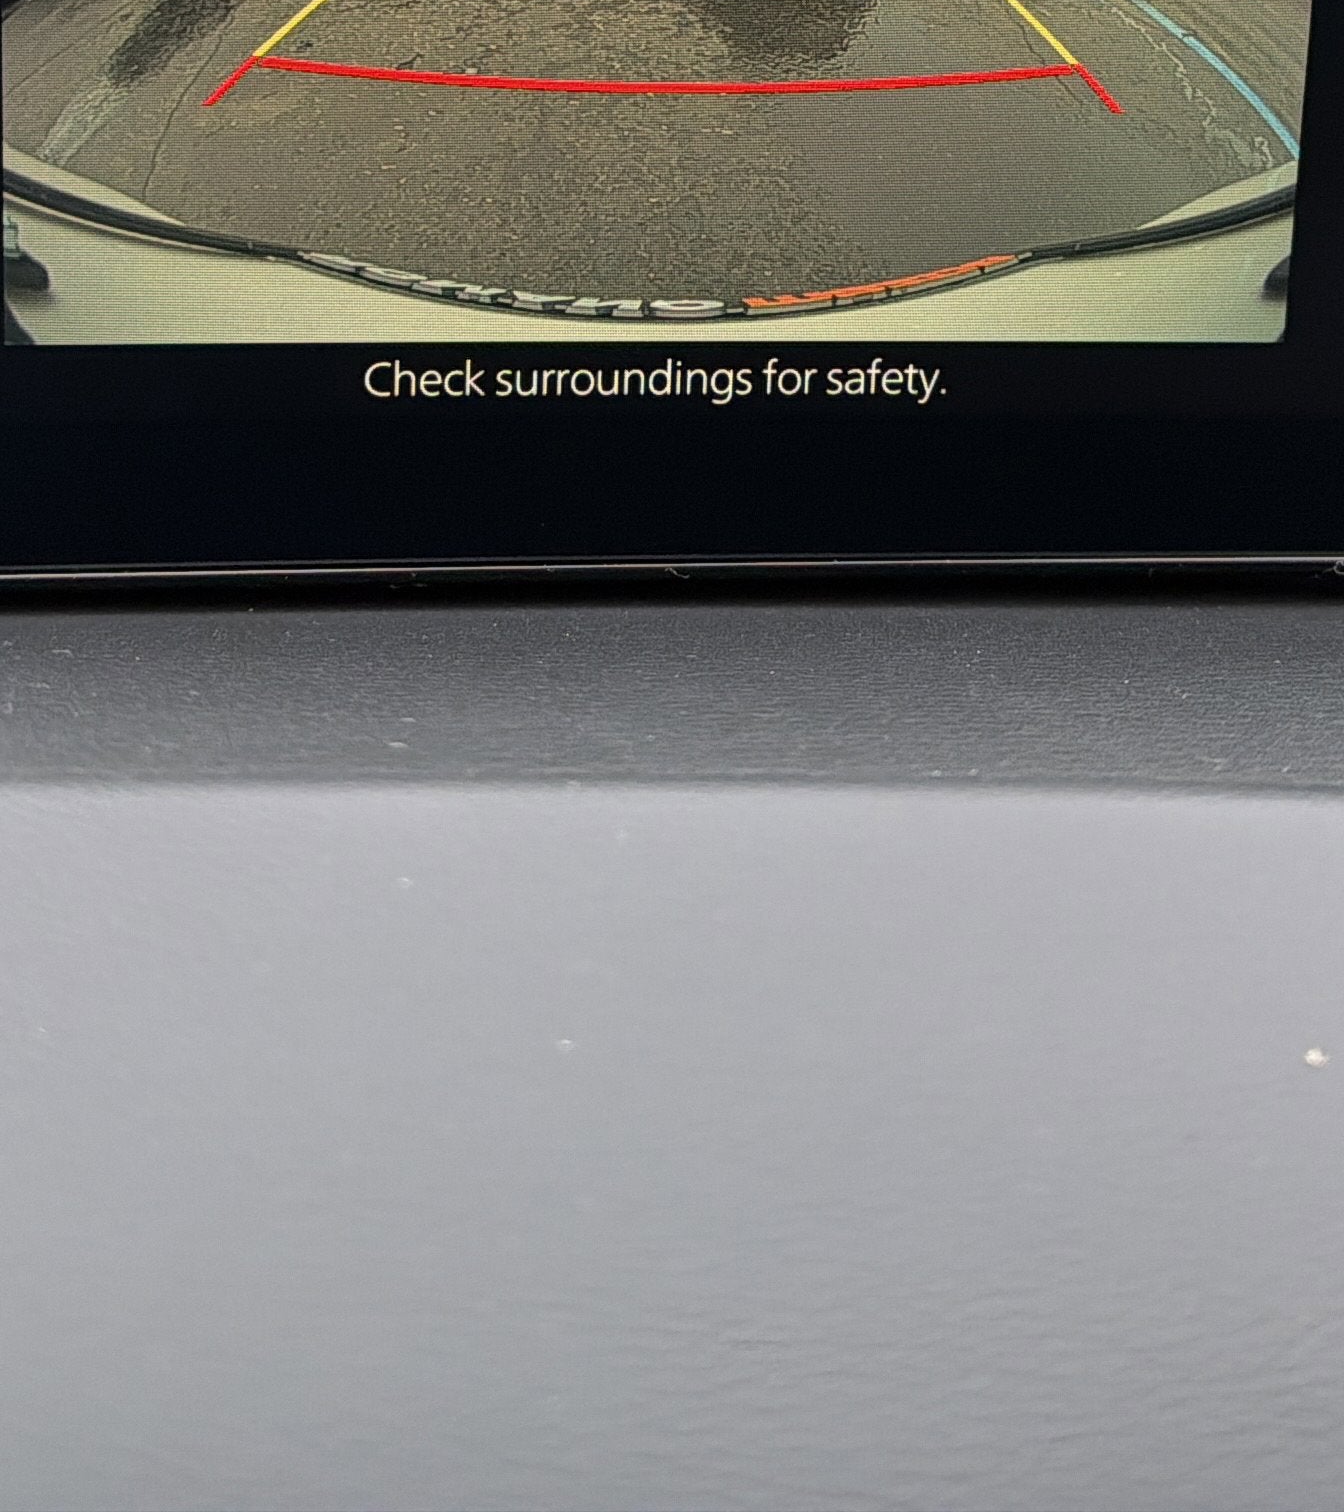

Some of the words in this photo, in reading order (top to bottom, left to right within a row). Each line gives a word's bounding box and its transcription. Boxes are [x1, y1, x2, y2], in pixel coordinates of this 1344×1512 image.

[363, 357, 486, 399] Check
[494, 357, 754, 406] surroundings
[762, 357, 819, 397] for
[825, 357, 948, 405] safety.
